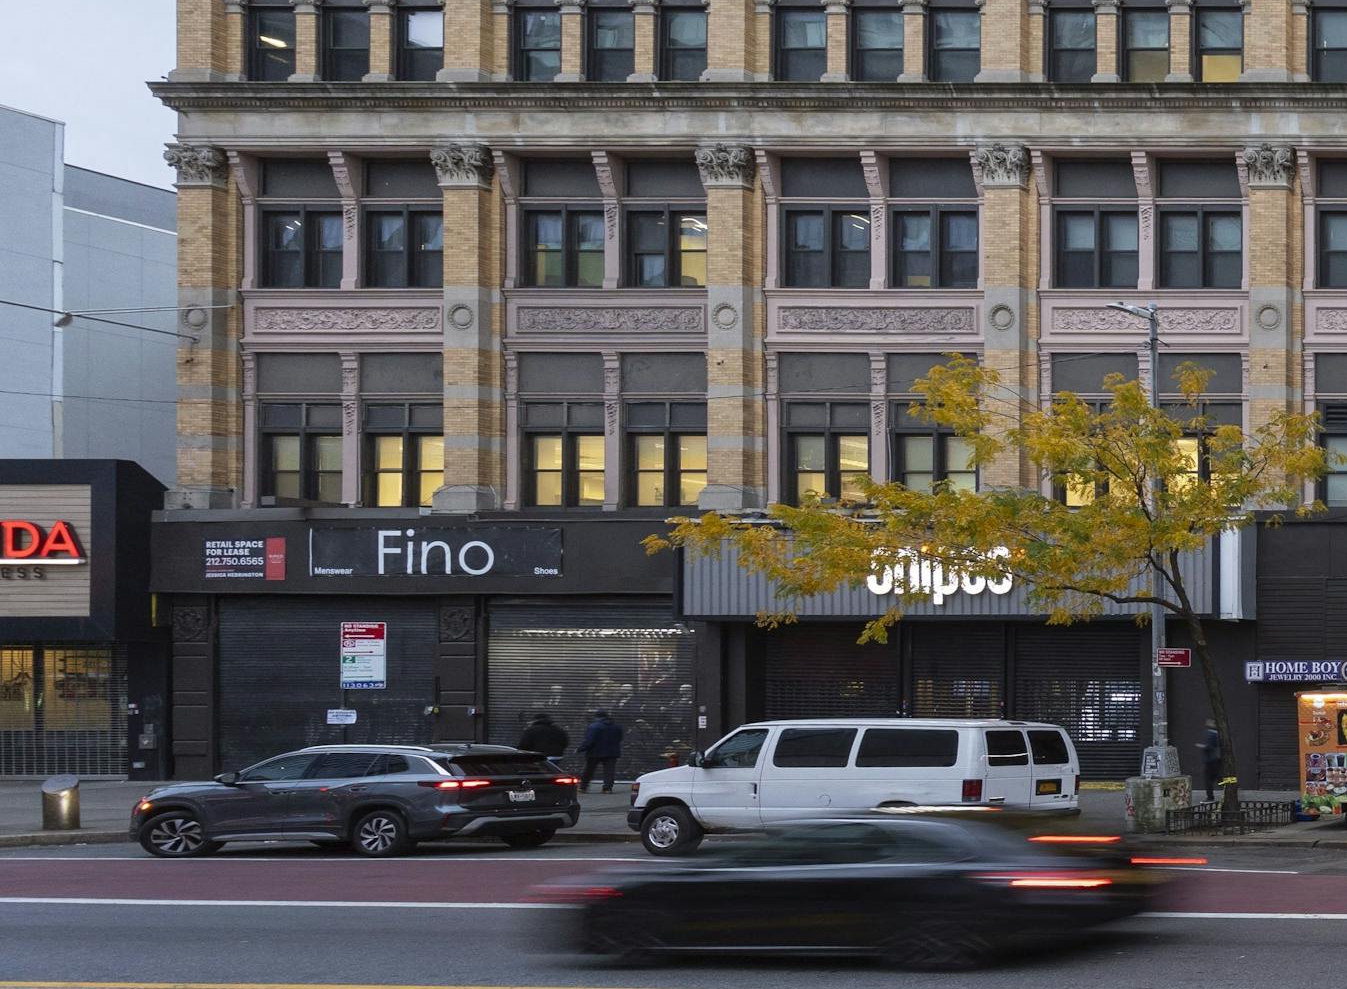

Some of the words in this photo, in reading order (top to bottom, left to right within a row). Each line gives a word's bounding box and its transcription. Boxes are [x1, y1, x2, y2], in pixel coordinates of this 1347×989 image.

[0, 519, 80, 559] DA
[378, 528, 495, 576] Fino
[206, 557, 264, 566] 212.750.6565
[314, 566, 353, 575] Menswear
[534, 567, 558, 575] Shoes
[1266, 662, 1308, 674] HOME
[1312, 662, 1342, 674] BOY
